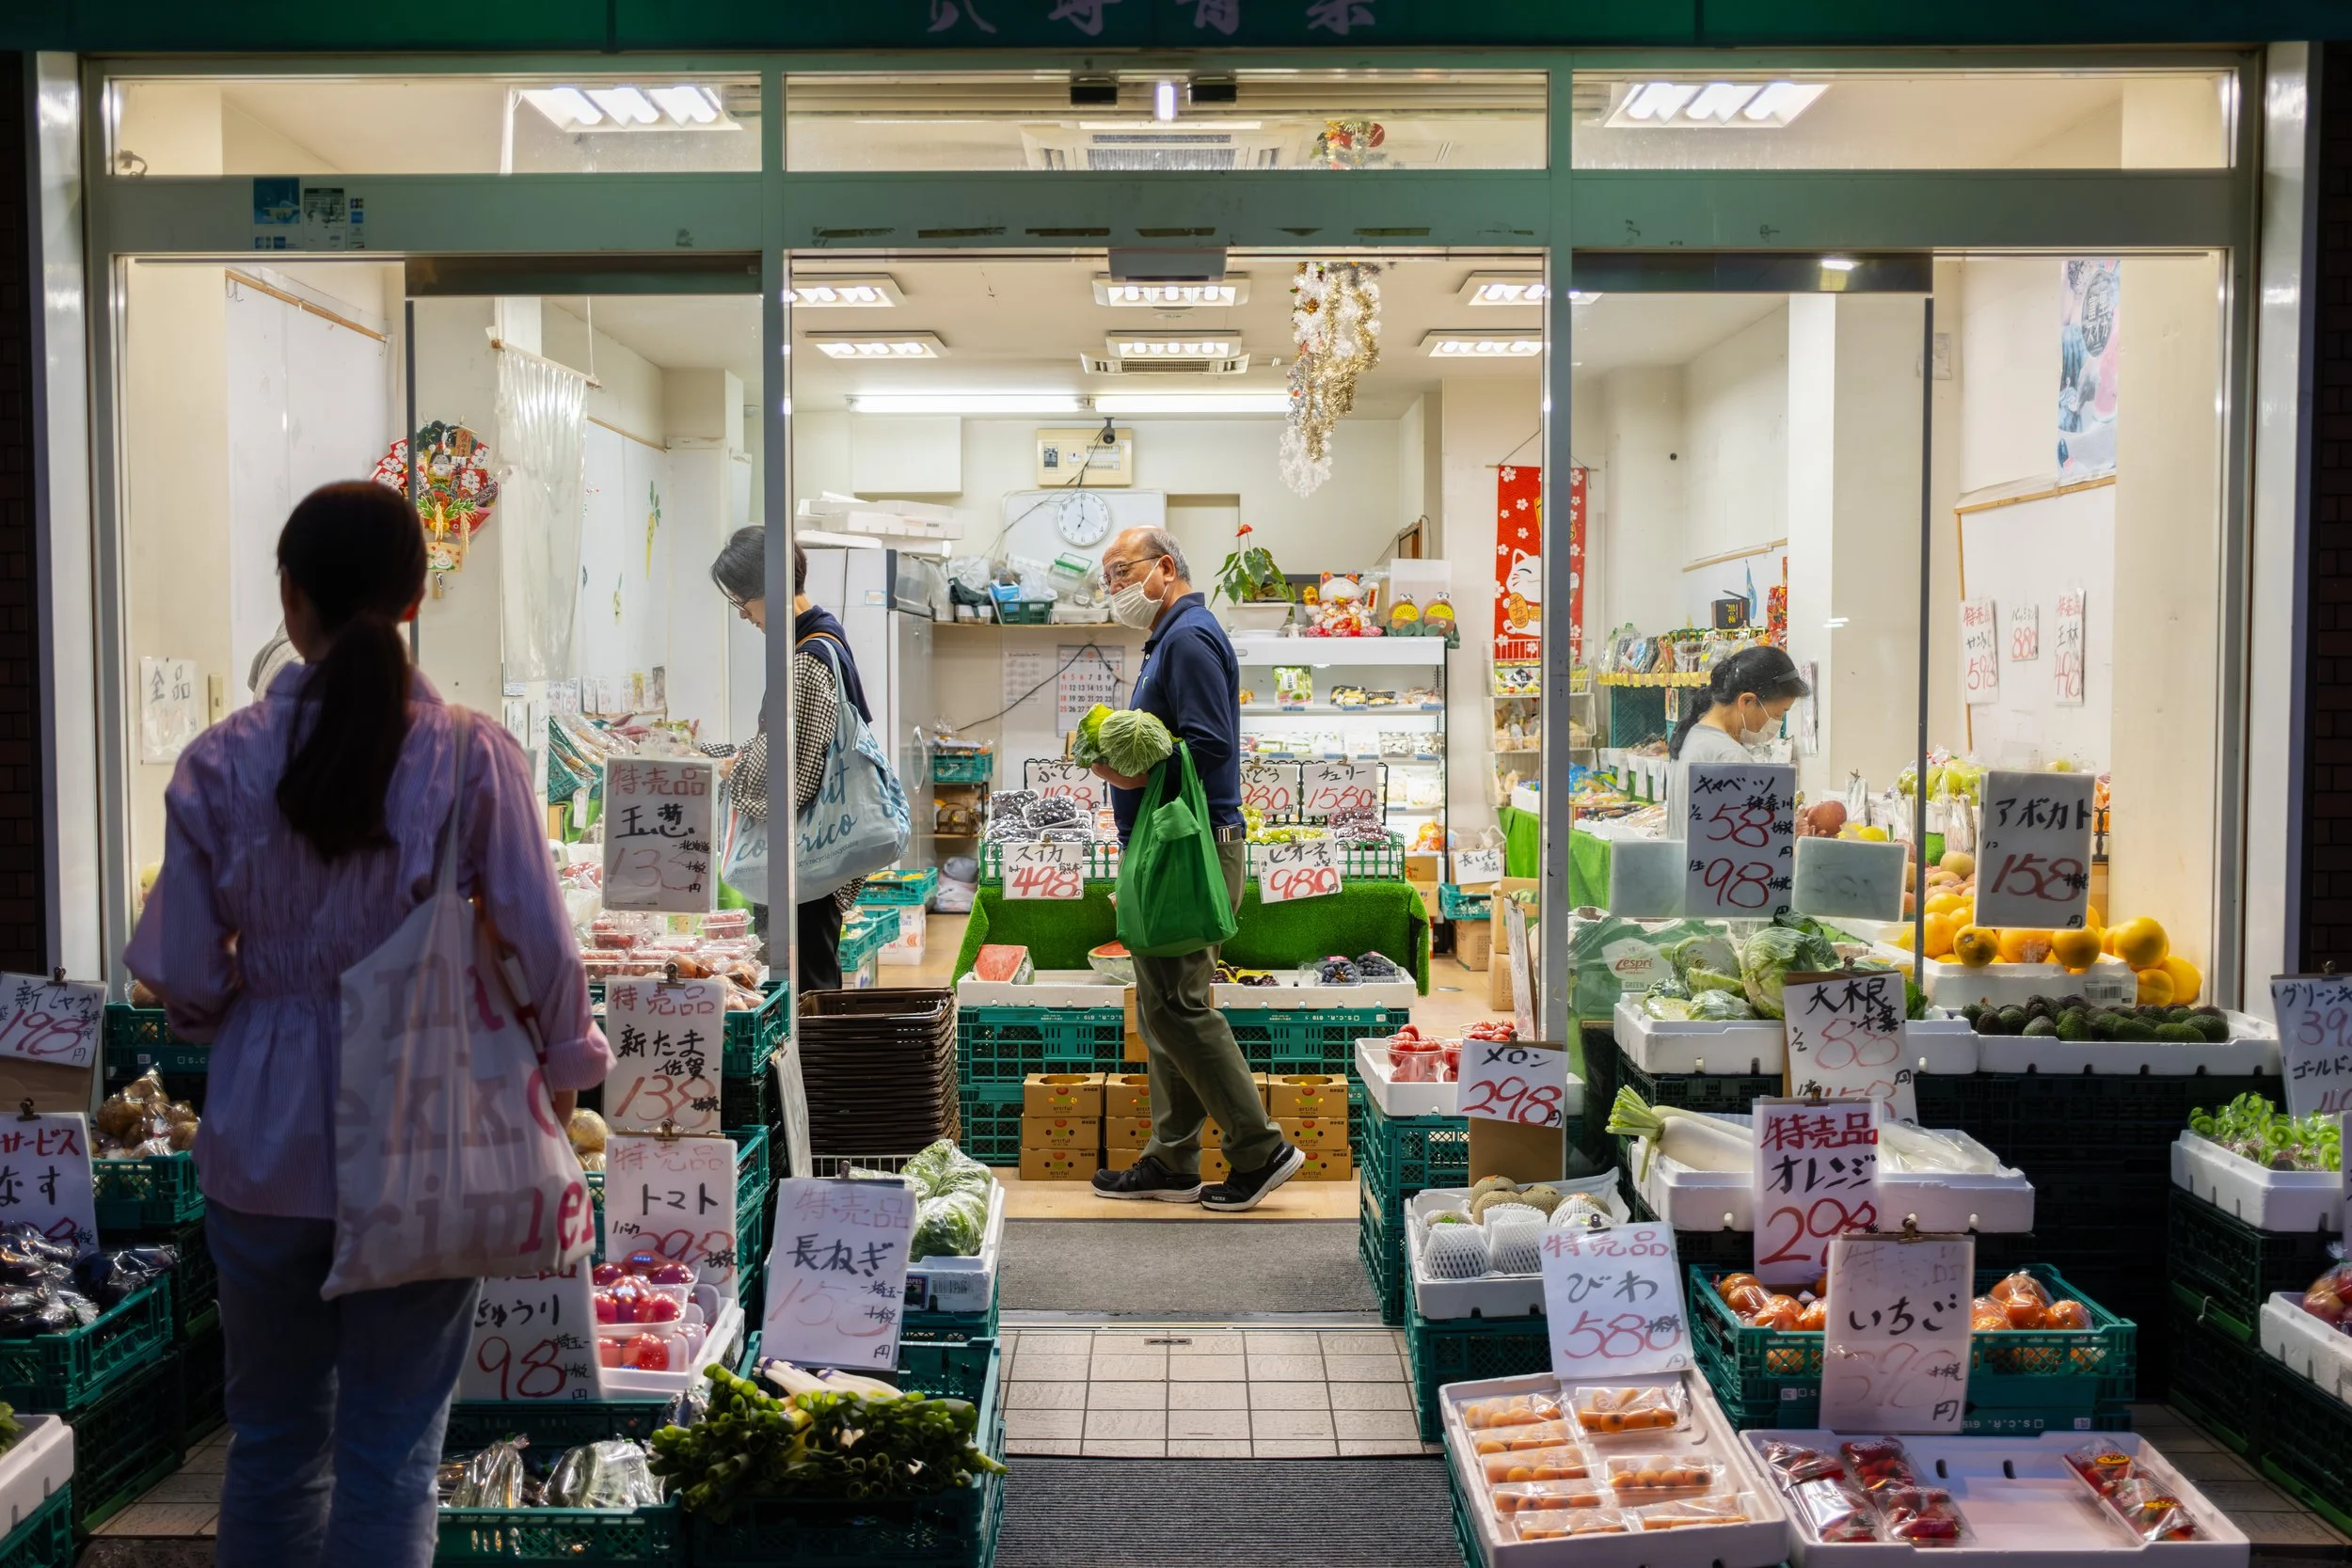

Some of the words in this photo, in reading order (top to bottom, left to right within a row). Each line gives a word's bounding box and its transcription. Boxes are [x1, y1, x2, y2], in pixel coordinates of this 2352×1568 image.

[2057, 623, 2079, 648] 王林
[151, 664, 191, 705] 全品
[1967, 655, 1997, 689] 598
[2055, 651, 2081, 698] 498
[608, 764, 706, 796] 特売品
[1693, 774, 1775, 795] キャベツ
[1309, 784, 1374, 810] 1580
[1707, 803, 1775, 847] 58
[1016, 844, 1063, 863] スイカ
[1270, 842, 1328, 863] ピオーネ
[1778, 846, 1793, 858] 円
[1012, 866, 1079, 897] 498
[1270, 867, 1338, 900] 980
[1704, 858, 1774, 908] 98
[1991, 853, 2083, 902] 158
[1615, 958, 1653, 971] Zespri
[612, 985, 716, 1016] 特売品
[1804, 977, 1891, 1015] 大根
[0, 1008, 88, 1055] 198
[617, 1024, 705, 1057] 新たま
[1815, 1018, 1900, 1069] 88
[2297, 1007, 2352, 1047] 39
[72, 1048, 87, 1062] 円
[1481, 1046, 1553, 1068] メロン
[2293, 1054, 2352, 1080] ゴールド
[1894, 1069, 1912, 1085] 円
[613, 1074, 716, 1129] 138
[1462, 1076, 1563, 1126] 298
[1543, 1109, 1562, 1127] 円
[1760, 1113, 1878, 1151] 特売品
[0, 1129, 80, 1156] サービス
[614, 1142, 724, 1172] 特売品
[0, 1165, 61, 1207] なす
[1766, 1154, 1877, 1195] オレンジ
[643, 1182, 719, 1215] トマト
[795, 1186, 910, 1228] 特売品
[787, 1233, 894, 1277] 長ねぎ
[1543, 1230, 1670, 1259] 特売品
[1566, 1270, 1659, 1304] びわ
[474, 1294, 560, 1328] きゅうり
[1849, 1293, 1958, 1336] いちご
[1564, 1309, 1681, 1359] 580
[873, 1344, 890, 1359] 円
[1665, 1353, 1687, 1369] 円
[477, 1336, 567, 1402] 98
[572, 1388, 587, 1401] 円
[1932, 1400, 1959, 1421] 円
